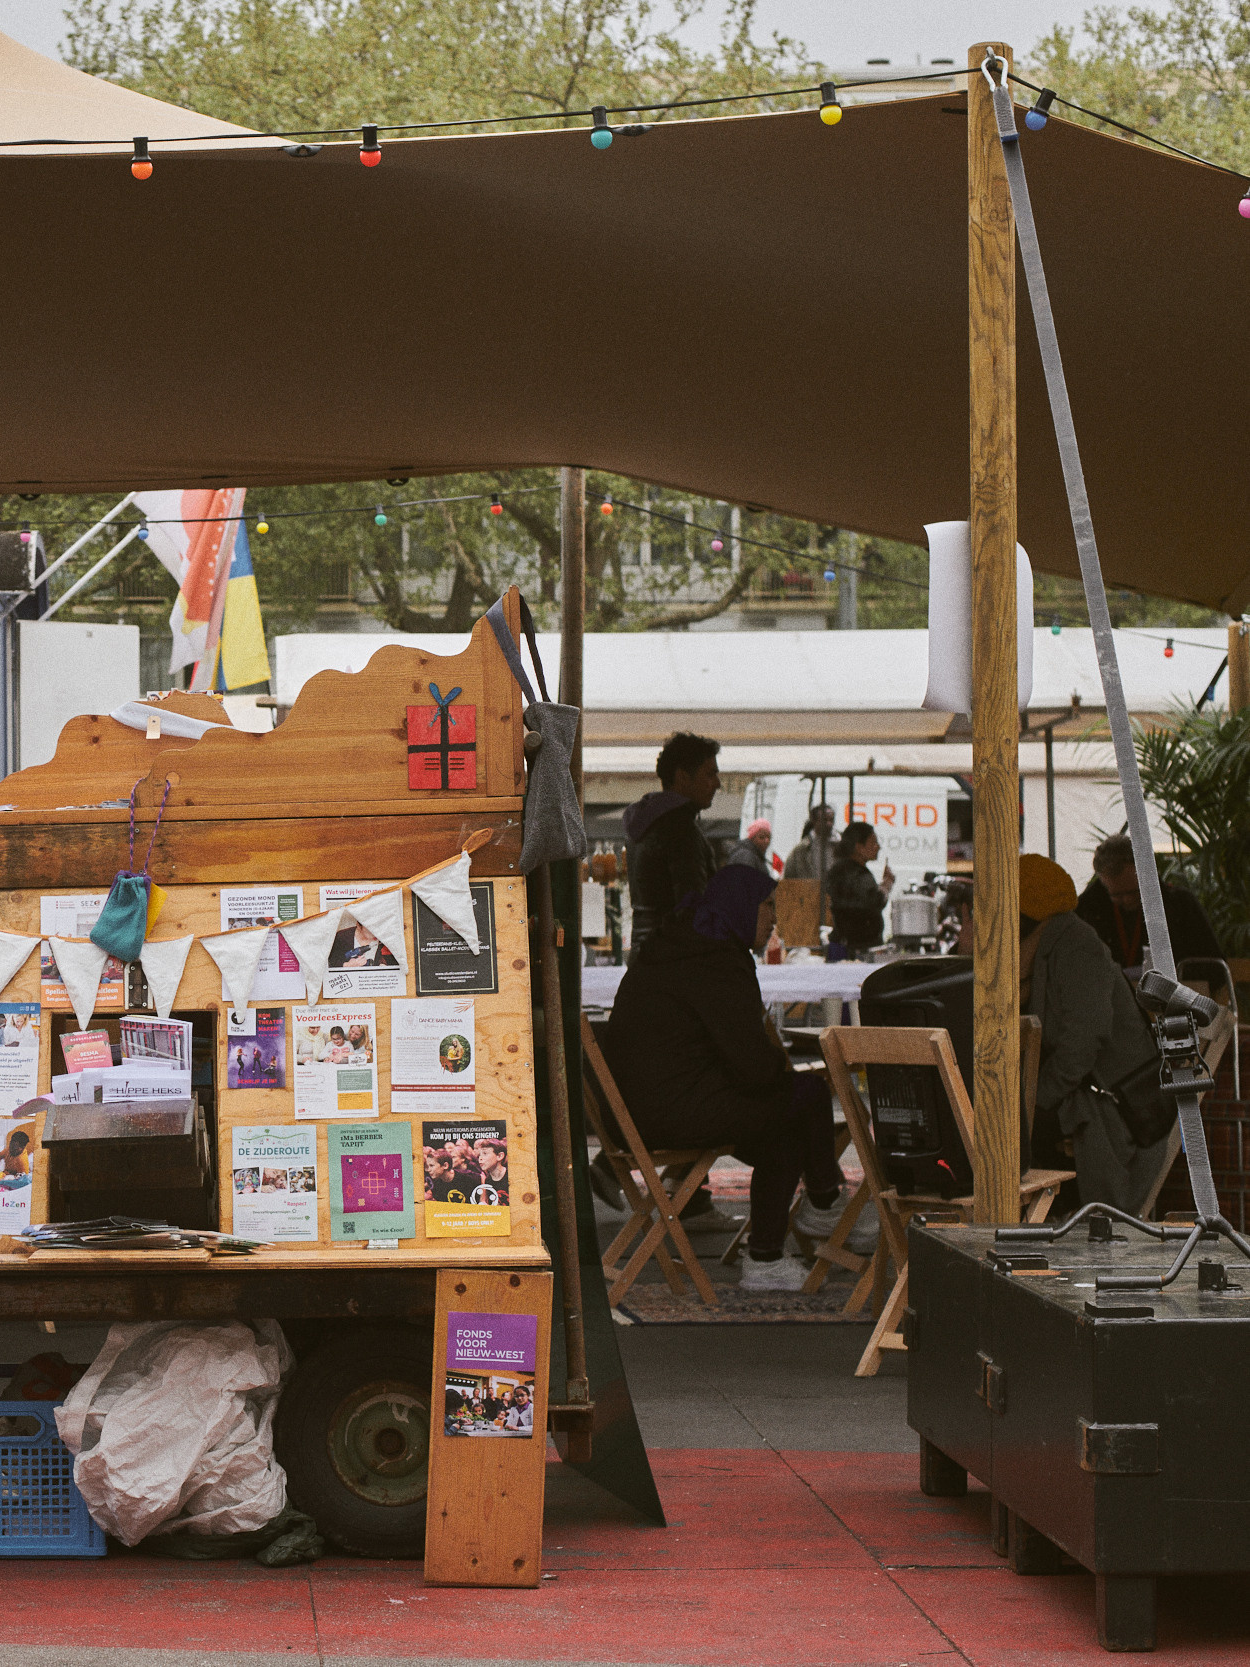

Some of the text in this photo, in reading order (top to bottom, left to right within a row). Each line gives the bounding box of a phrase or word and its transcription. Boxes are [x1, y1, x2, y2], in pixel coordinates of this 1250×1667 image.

[845, 803, 938, 827] GRID
[296, 1013, 372, 1023] VoorleesExpress
[238, 1147, 310, 1156] DE ZIJDEROUTE
[2, 1197, 26, 1208] lezen
[456, 1329, 493, 1339] FONDS
[456, 1339, 487, 1348] VOOR
[455, 1349, 525, 1359] NIEUW-WEST
